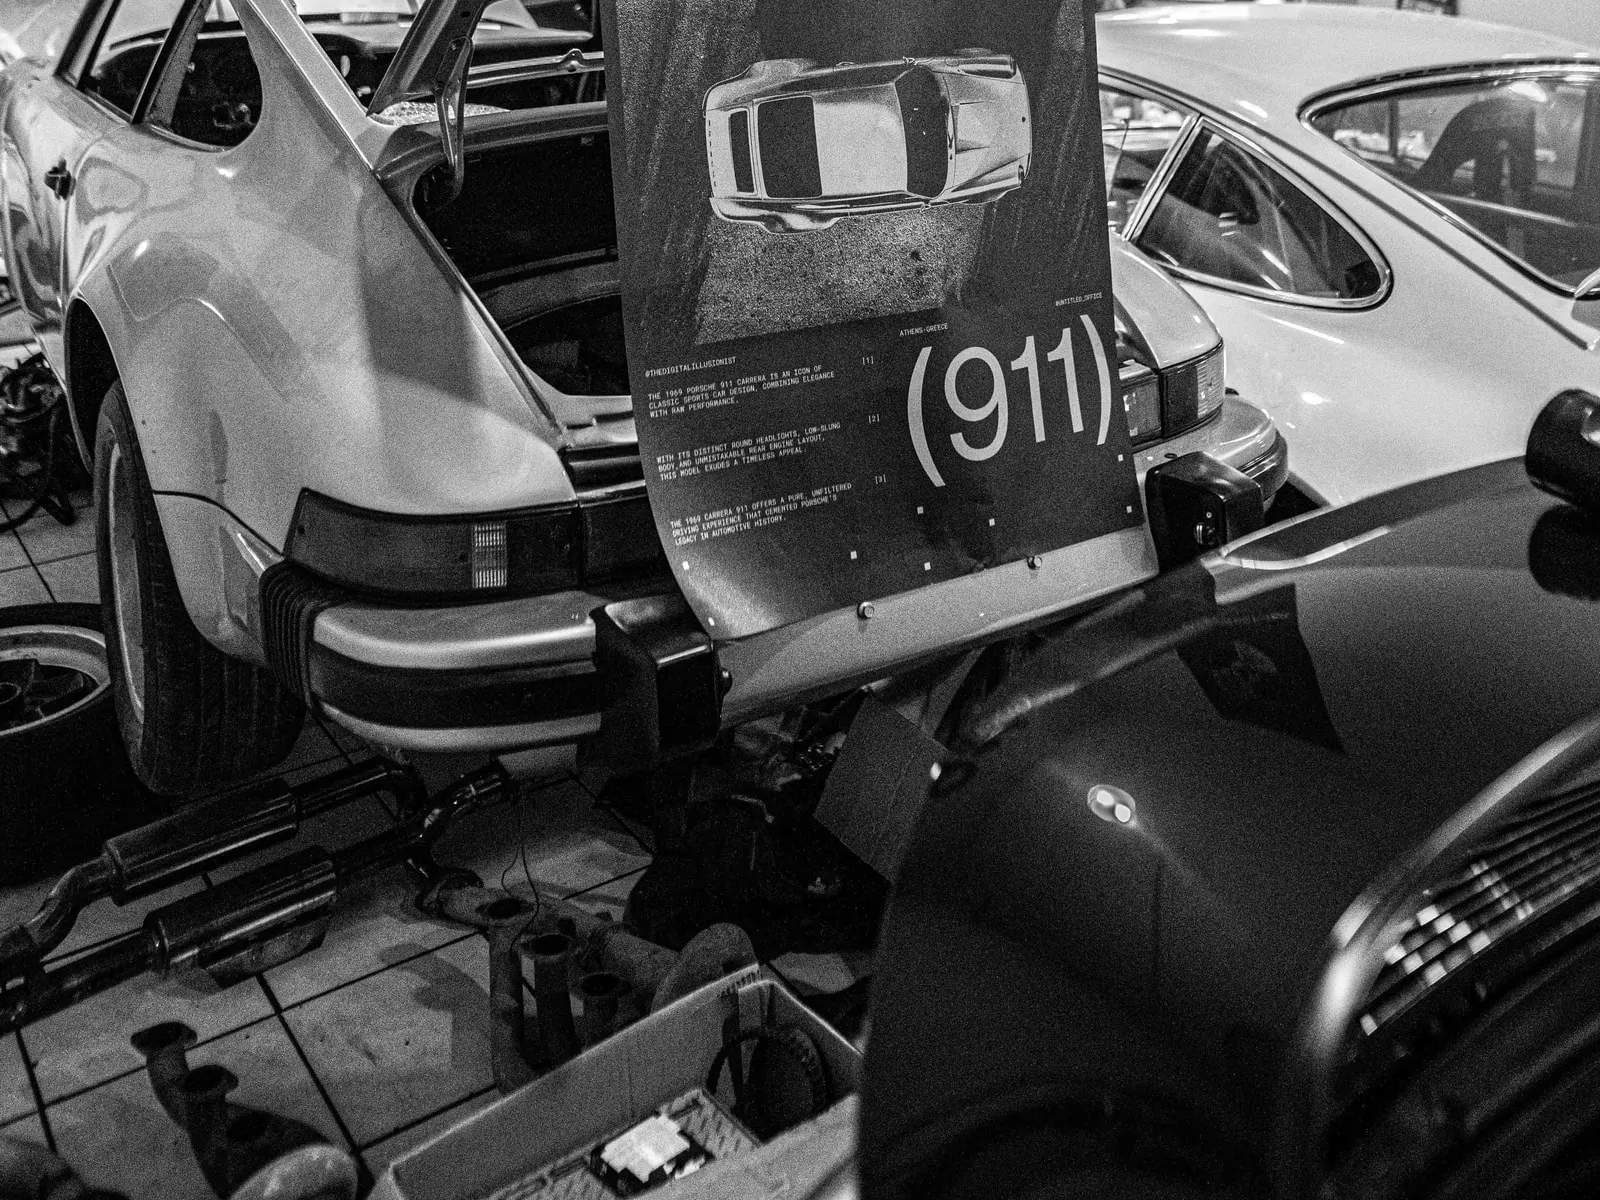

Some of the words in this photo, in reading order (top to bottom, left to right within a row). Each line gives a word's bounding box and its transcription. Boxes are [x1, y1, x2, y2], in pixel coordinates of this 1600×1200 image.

[645, 356, 736, 378] @THEDIGITALILLUSIONIST
[862, 355, 874, 365] [1]
[648, 392, 661, 401] THE
[666, 388, 683, 398] 1969
[686, 382, 716, 394] PORSCHE
[720, 380, 733, 388] 911
[737, 374, 766, 386] CARRERA
[770, 372, 779, 380] IS
[782, 370, 790, 378] AN
[794, 367, 811, 376] ICON
[648, 398, 680, 410] CLASSIC
[683, 392, 709, 404] SPORTS
[712, 390, 726, 398] CAR
[762, 377, 799, 390] COMBINING
[802, 371, 835, 383] ELEGANCE
[649, 409, 668, 418] WITH
[671, 406, 685, 414] RAW
[688, 396, 739, 411] PERFORMANCE.
[907, 314, 1111, 487] (911)
[868, 413, 880, 424] [2]
[656, 454, 674, 464] WITH
[678, 450, 691, 460] ITS
[693, 443, 727, 456] DISTINCT
[731, 439, 753, 448] ROUND
[804, 421, 841, 436] LOW-SLUNG
[695, 449, 745, 465] UNMISTAKABLE
[748, 445, 766, 454] REAR
[769, 440, 794, 450] ENGINE
[798, 434, 825, 445] LAYOUT,
[660, 471, 677, 481] THIS
[679, 467, 700, 477] MODEL
[704, 460, 730, 472] EXUDES
[742, 451, 775, 464] TIMELESS
[875, 474, 887, 484] [3]
[670, 519, 682, 528] THE
[685, 515, 701, 525] 1969
[704, 508, 733, 521] CARRERA
[735, 505, 748, 513] 911
[751, 498, 777, 510] OFFERS
[811, 482, 852, 497] UNFILTERED
[672, 524, 699, 537] DRIVING
[702, 515, 741, 531] EXPERIENCE
[746, 510, 761, 520] THAT
[765, 503, 798, 516] CEMENTED
[801, 494, 837, 508] PORSCHE'S
[675, 535, 697, 546] LEGACY
[700, 532, 709, 541] IN
[712, 521, 751, 537] AUTOMOTIVE
[754, 515, 786, 527] HISTORY.
